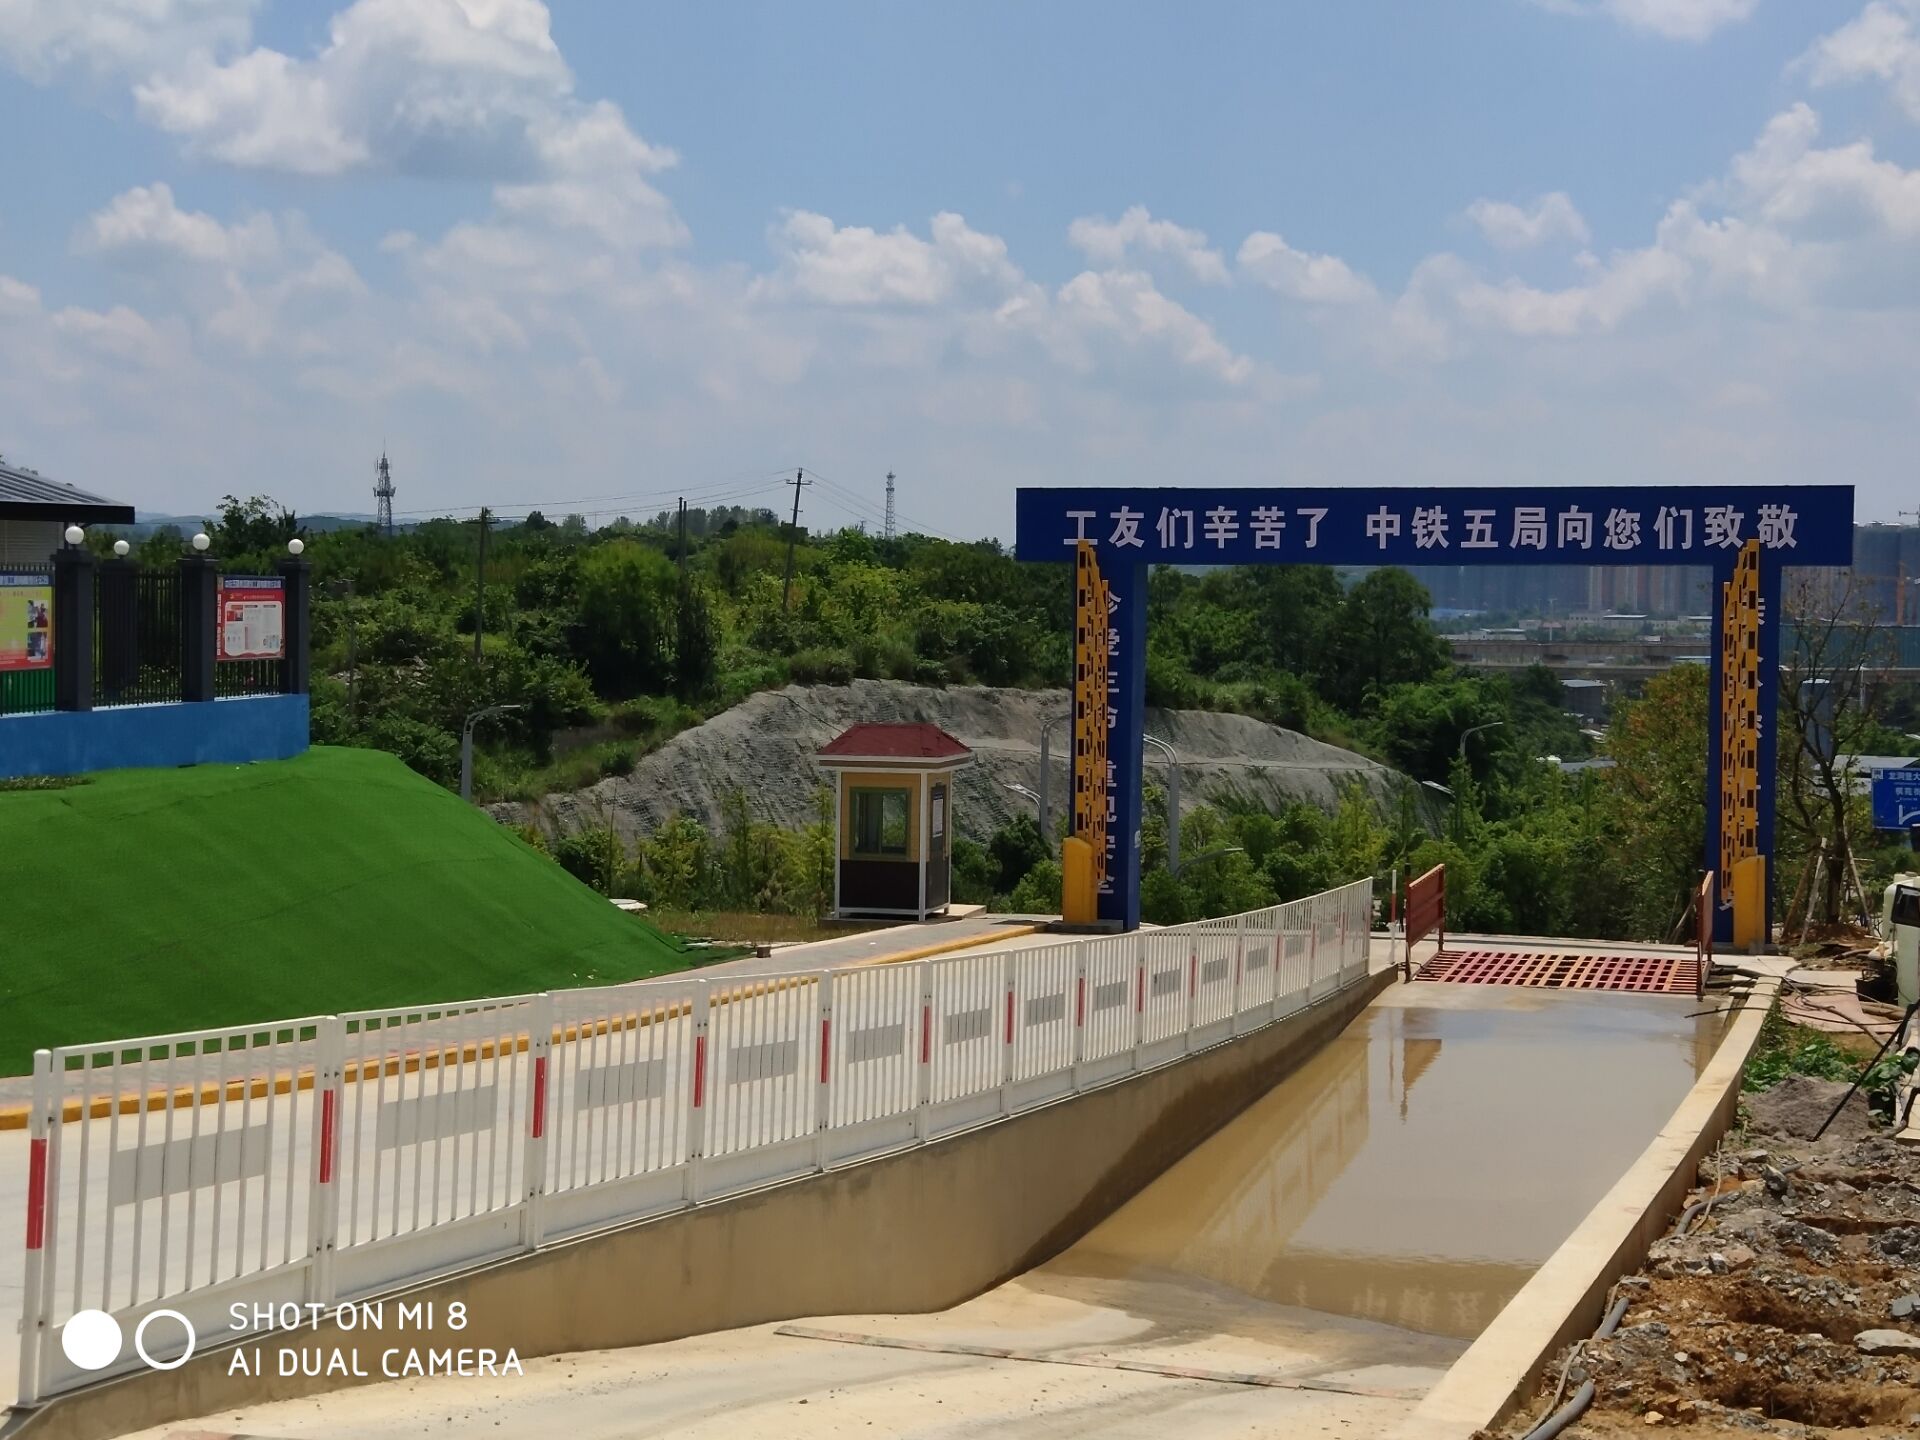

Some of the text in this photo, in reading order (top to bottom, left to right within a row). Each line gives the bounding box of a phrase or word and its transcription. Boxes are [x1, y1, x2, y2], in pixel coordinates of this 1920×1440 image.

[1063, 504, 1799, 550] 工友们辛苦了 中铁五局向您们致敬
